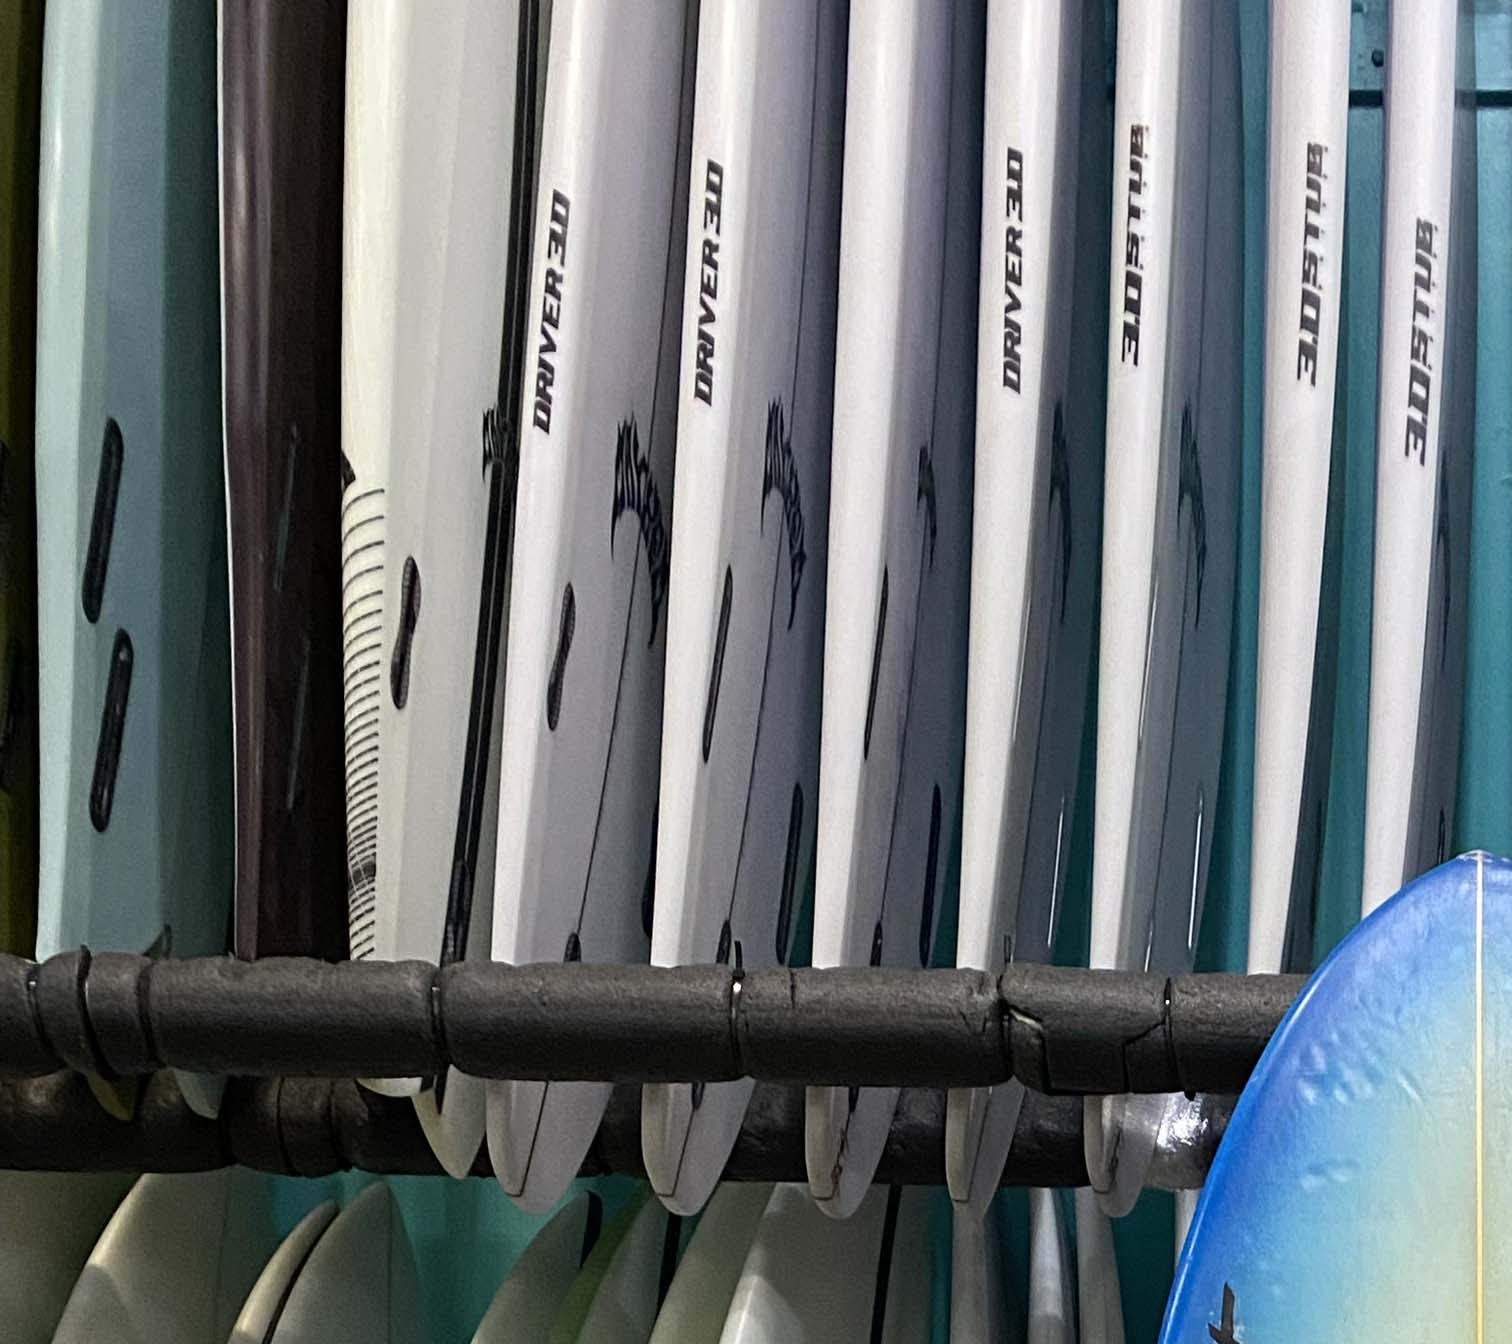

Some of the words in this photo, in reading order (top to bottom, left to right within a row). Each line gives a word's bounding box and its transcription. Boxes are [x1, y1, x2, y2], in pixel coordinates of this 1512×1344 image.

[533, 267, 563, 435] DRIVER
[694, 238, 719, 407] DRIVER
[1003, 226, 1022, 395] DRIVER
